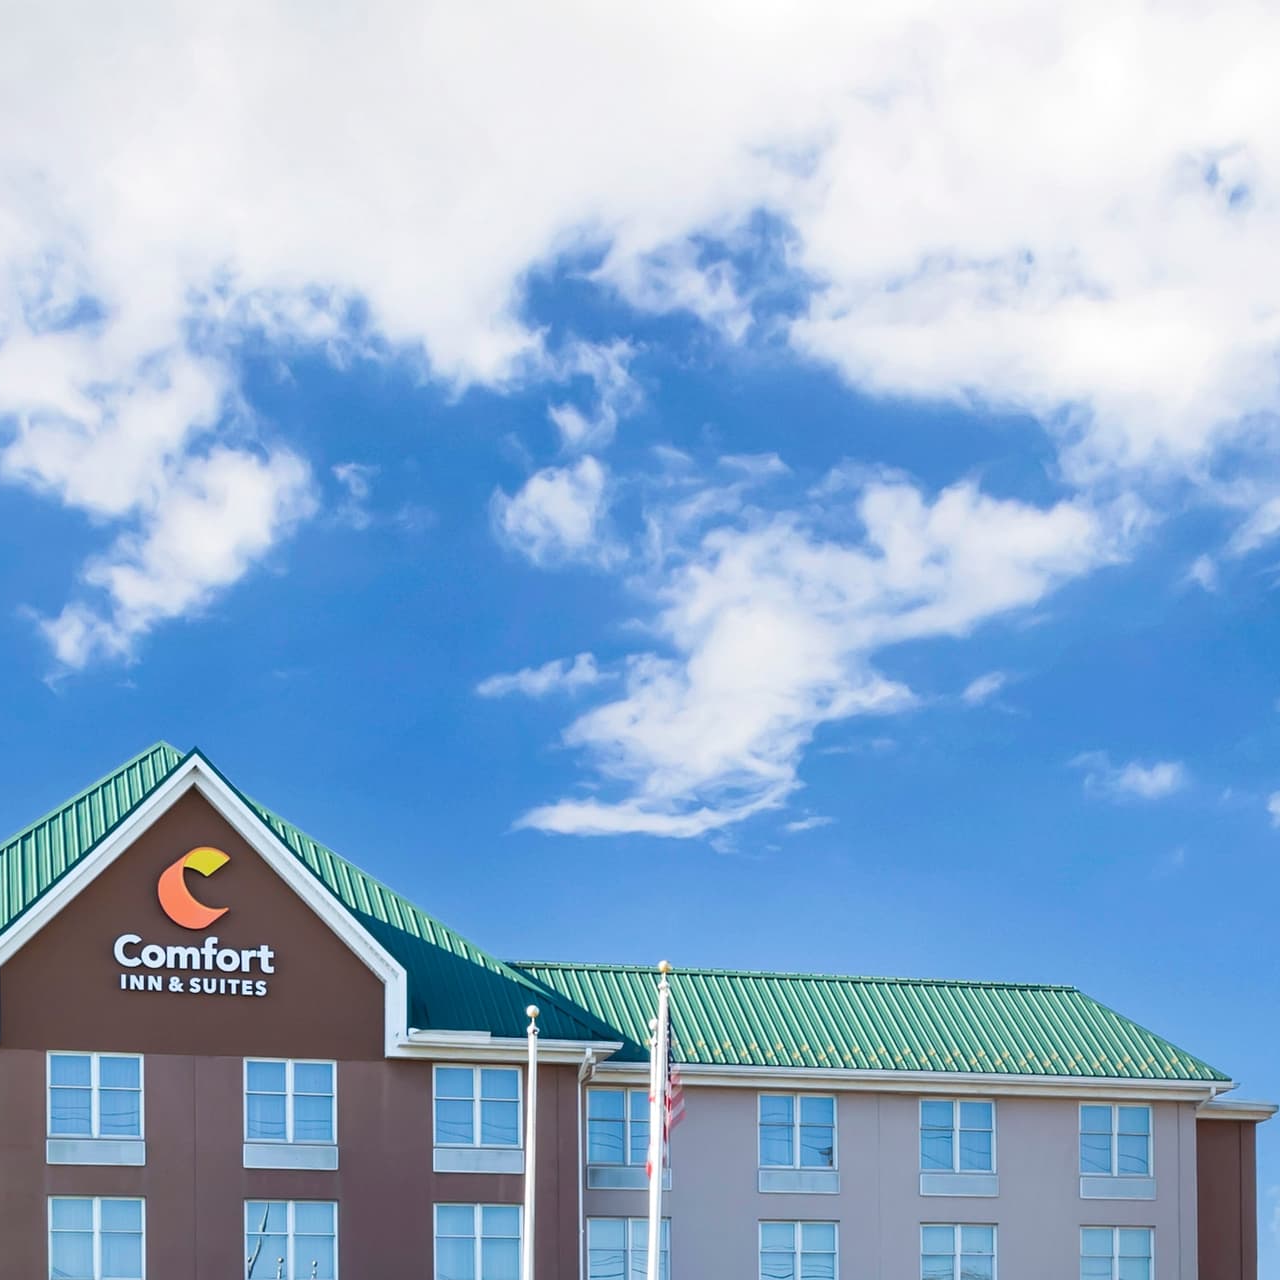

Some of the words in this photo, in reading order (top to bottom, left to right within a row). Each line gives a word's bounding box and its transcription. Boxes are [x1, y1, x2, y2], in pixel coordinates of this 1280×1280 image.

[114, 934, 275, 974] Comfort
[120, 973, 163, 991] INN
[168, 976, 184, 993] &
[189, 977, 267, 996] SUITES
